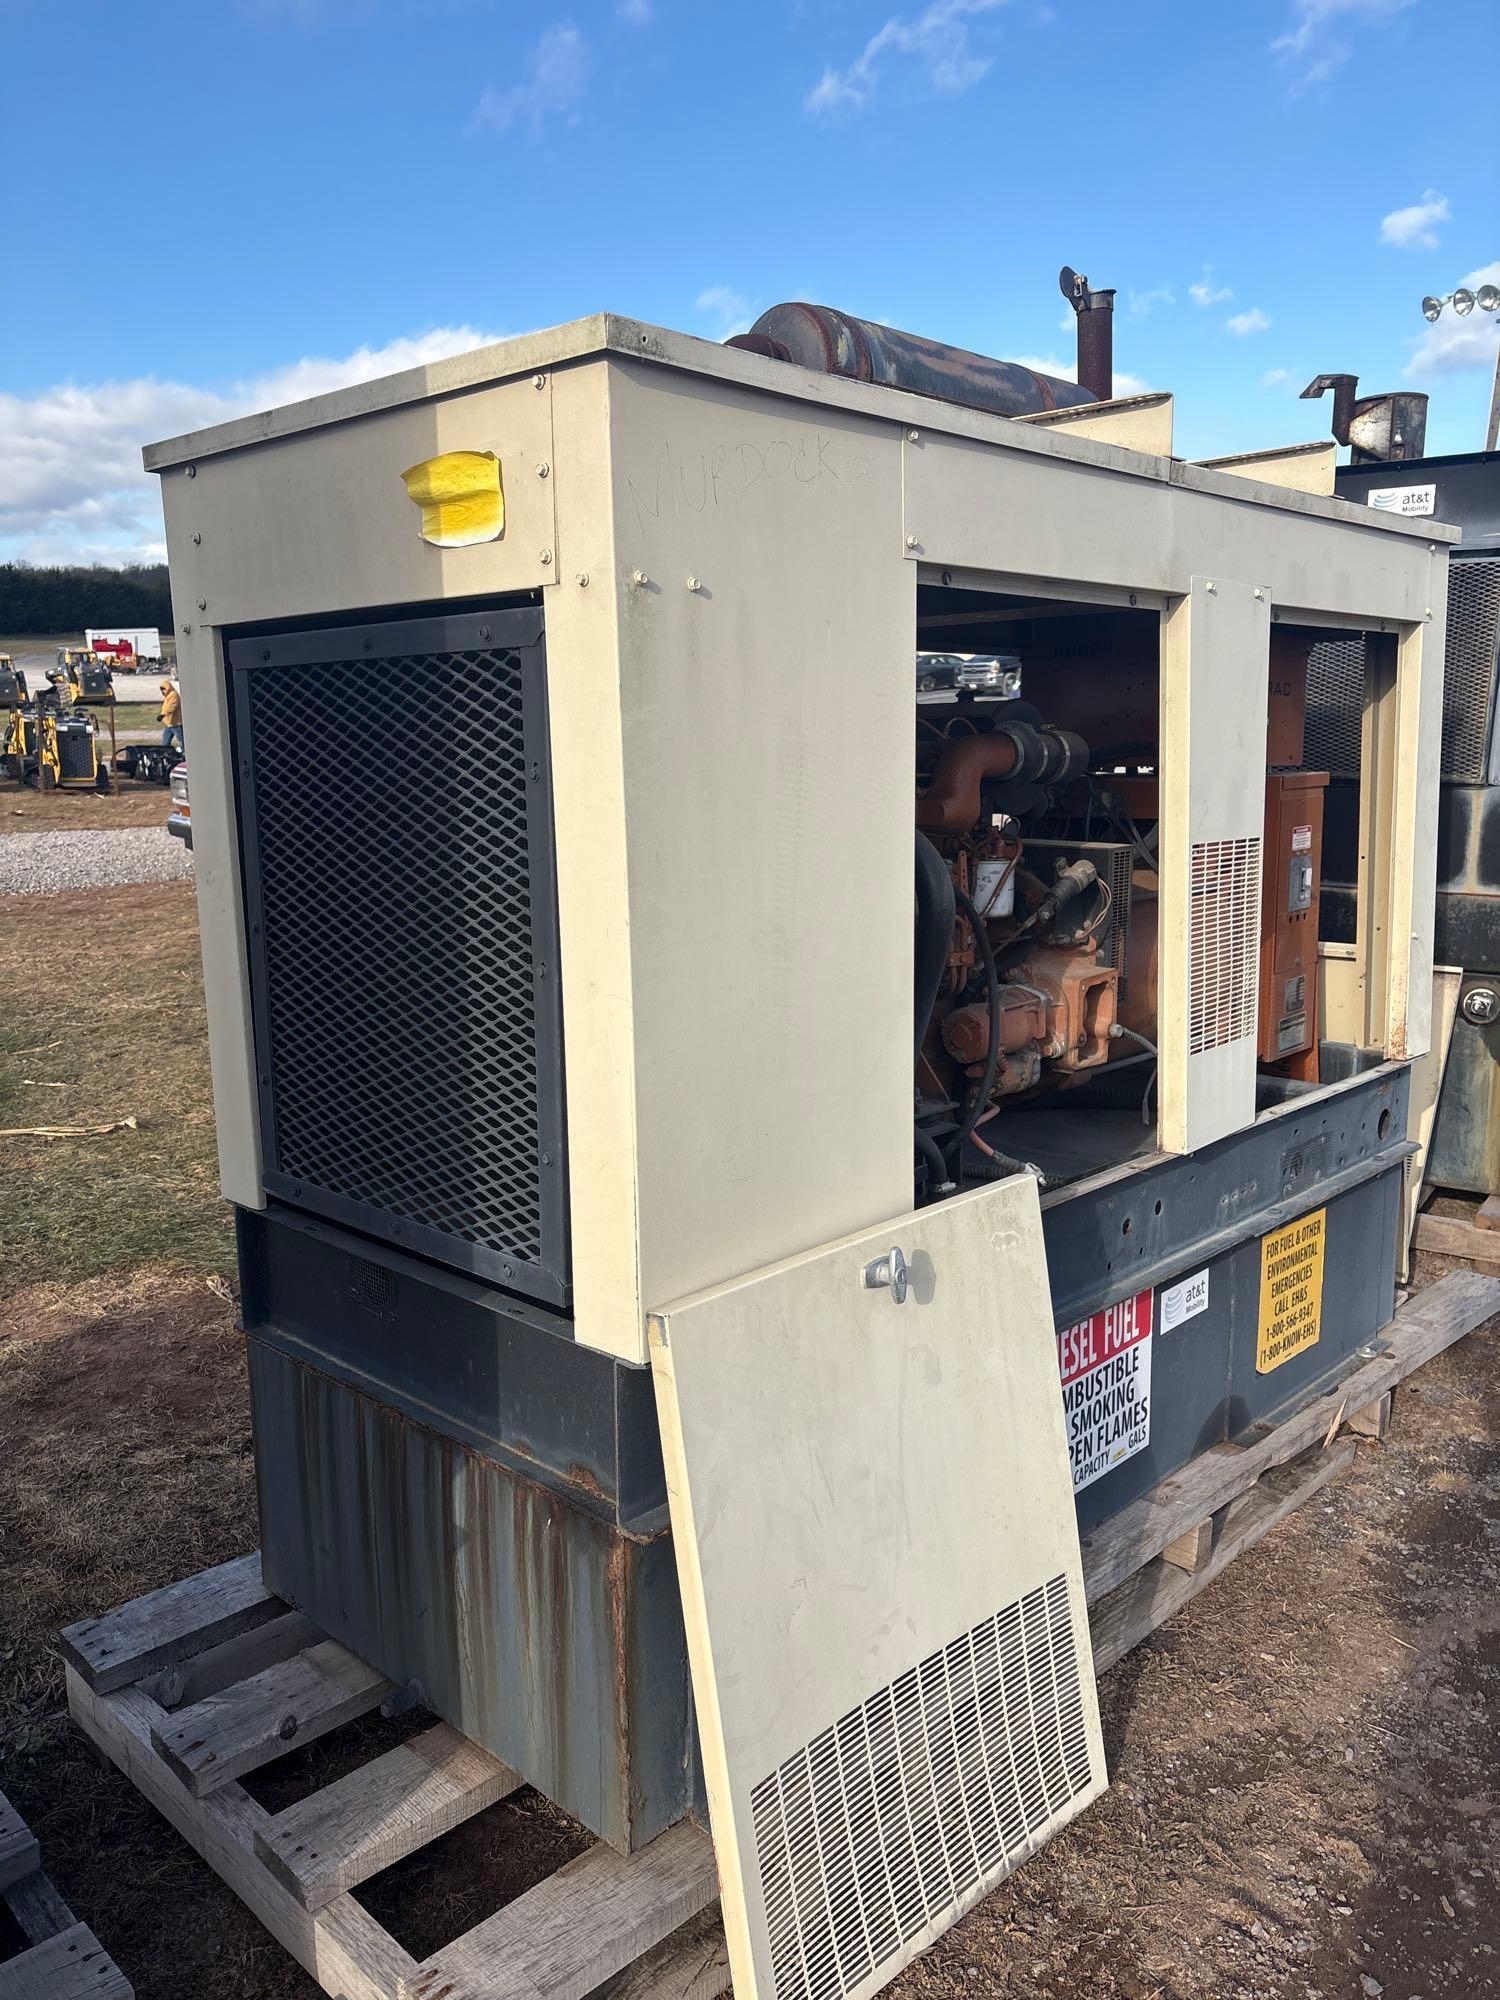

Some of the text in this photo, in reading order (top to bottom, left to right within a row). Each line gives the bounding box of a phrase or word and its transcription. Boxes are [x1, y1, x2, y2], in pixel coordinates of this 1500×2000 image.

[1402, 491, 1430, 505] at&t
[1402, 505, 1429, 513] Mobility
[1266, 1219, 1321, 1260] FOR FUEL & OTHER
[1267, 1241, 1318, 1281] ENVIRONMENTAL
[1271, 1262, 1313, 1298] EMERGENCIES
[1186, 1279, 1205, 1303] at&t
[1274, 1295, 1289, 1317] CALL
[1056, 1295, 1139, 1380] ESEL FUEL
[1266, 1301, 1314, 1342] 1-800-566-9347
[1260, 1318, 1317, 1368] (1-800-KNOW-EHS)
[1062, 1346, 1139, 1414] MBUSTIBLE
[1071, 1376, 1135, 1440] SMOKING
[1069, 1396, 1148, 1467] PEN FLAMES
[1073, 1448, 1110, 1486] CAPACITY
[1128, 1425, 1147, 1449] GALS
